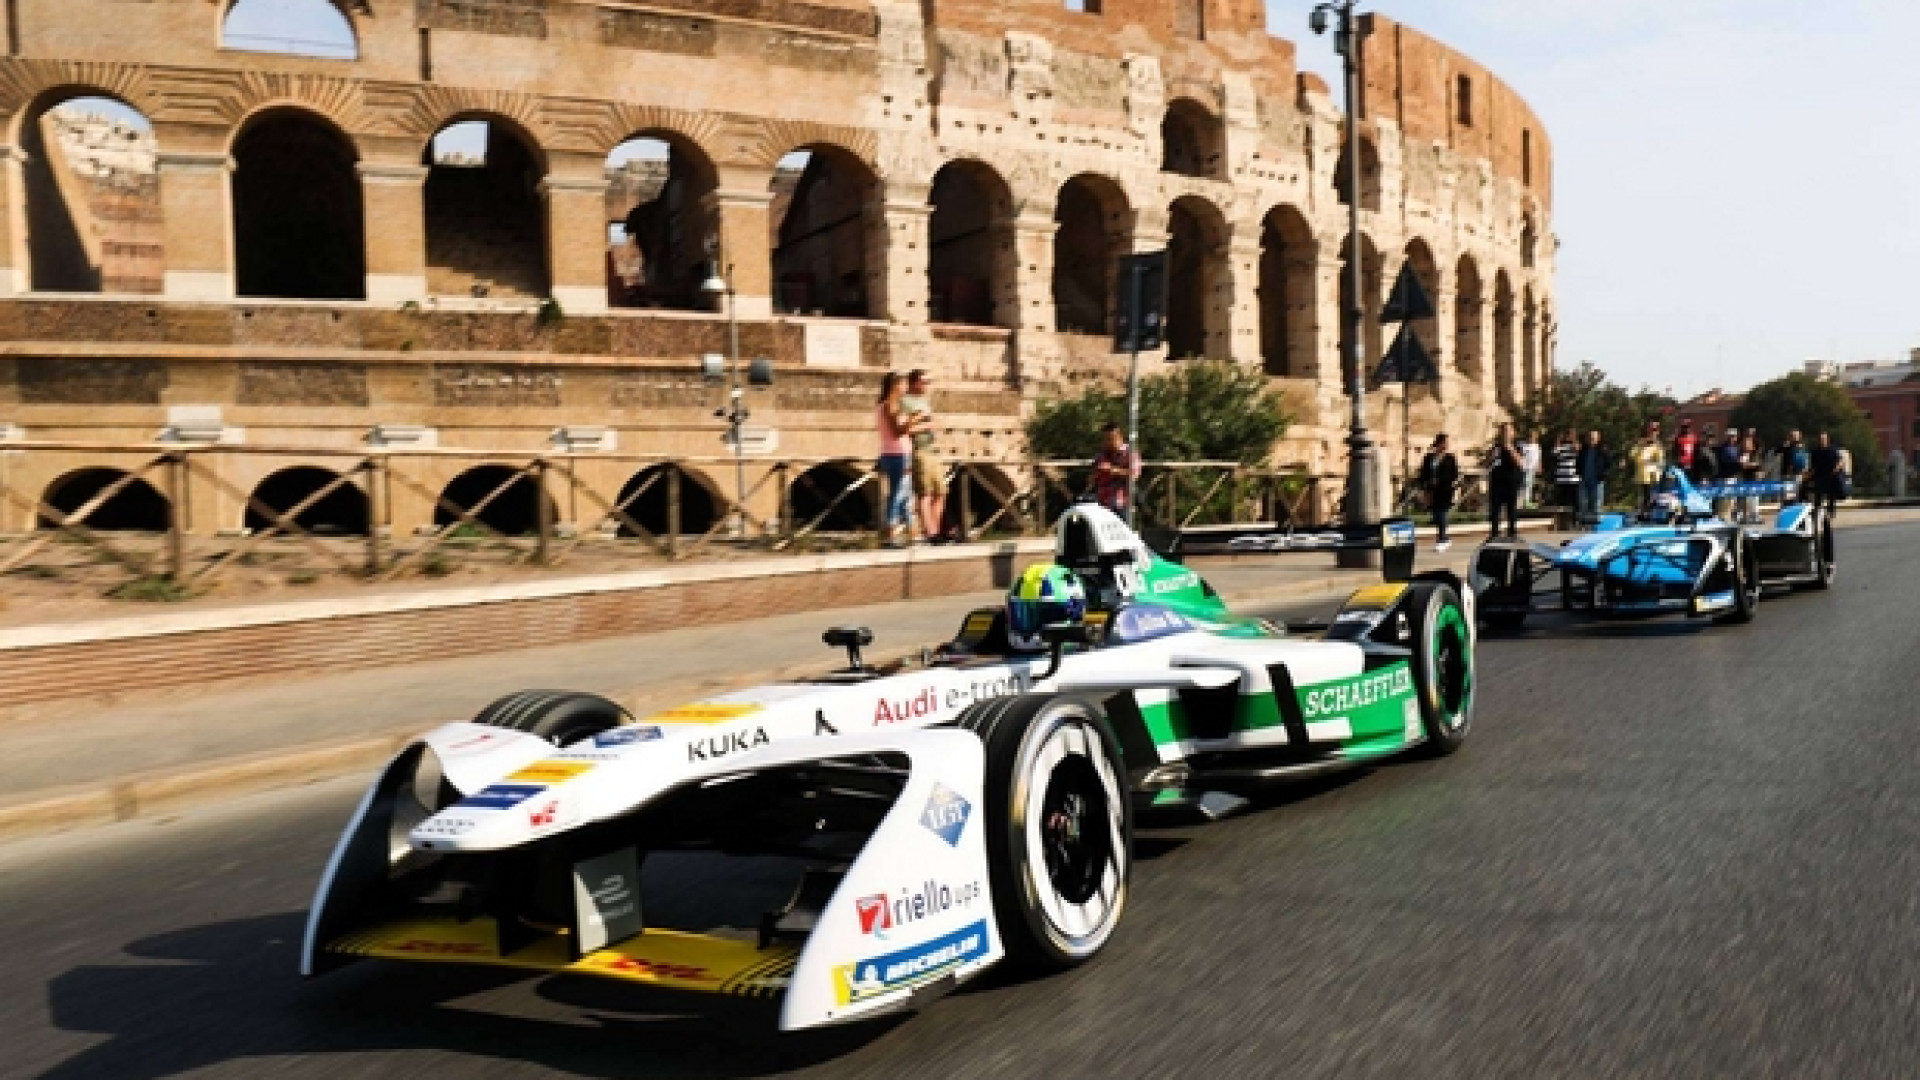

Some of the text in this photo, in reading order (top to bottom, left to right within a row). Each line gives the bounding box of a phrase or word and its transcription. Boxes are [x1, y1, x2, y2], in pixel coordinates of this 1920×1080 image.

[873, 686, 937, 726] Audi
[1305, 666, 1412, 718] SCHAEFFLER
[687, 726, 770, 763] KUKA
[893, 879, 952, 926] riello
